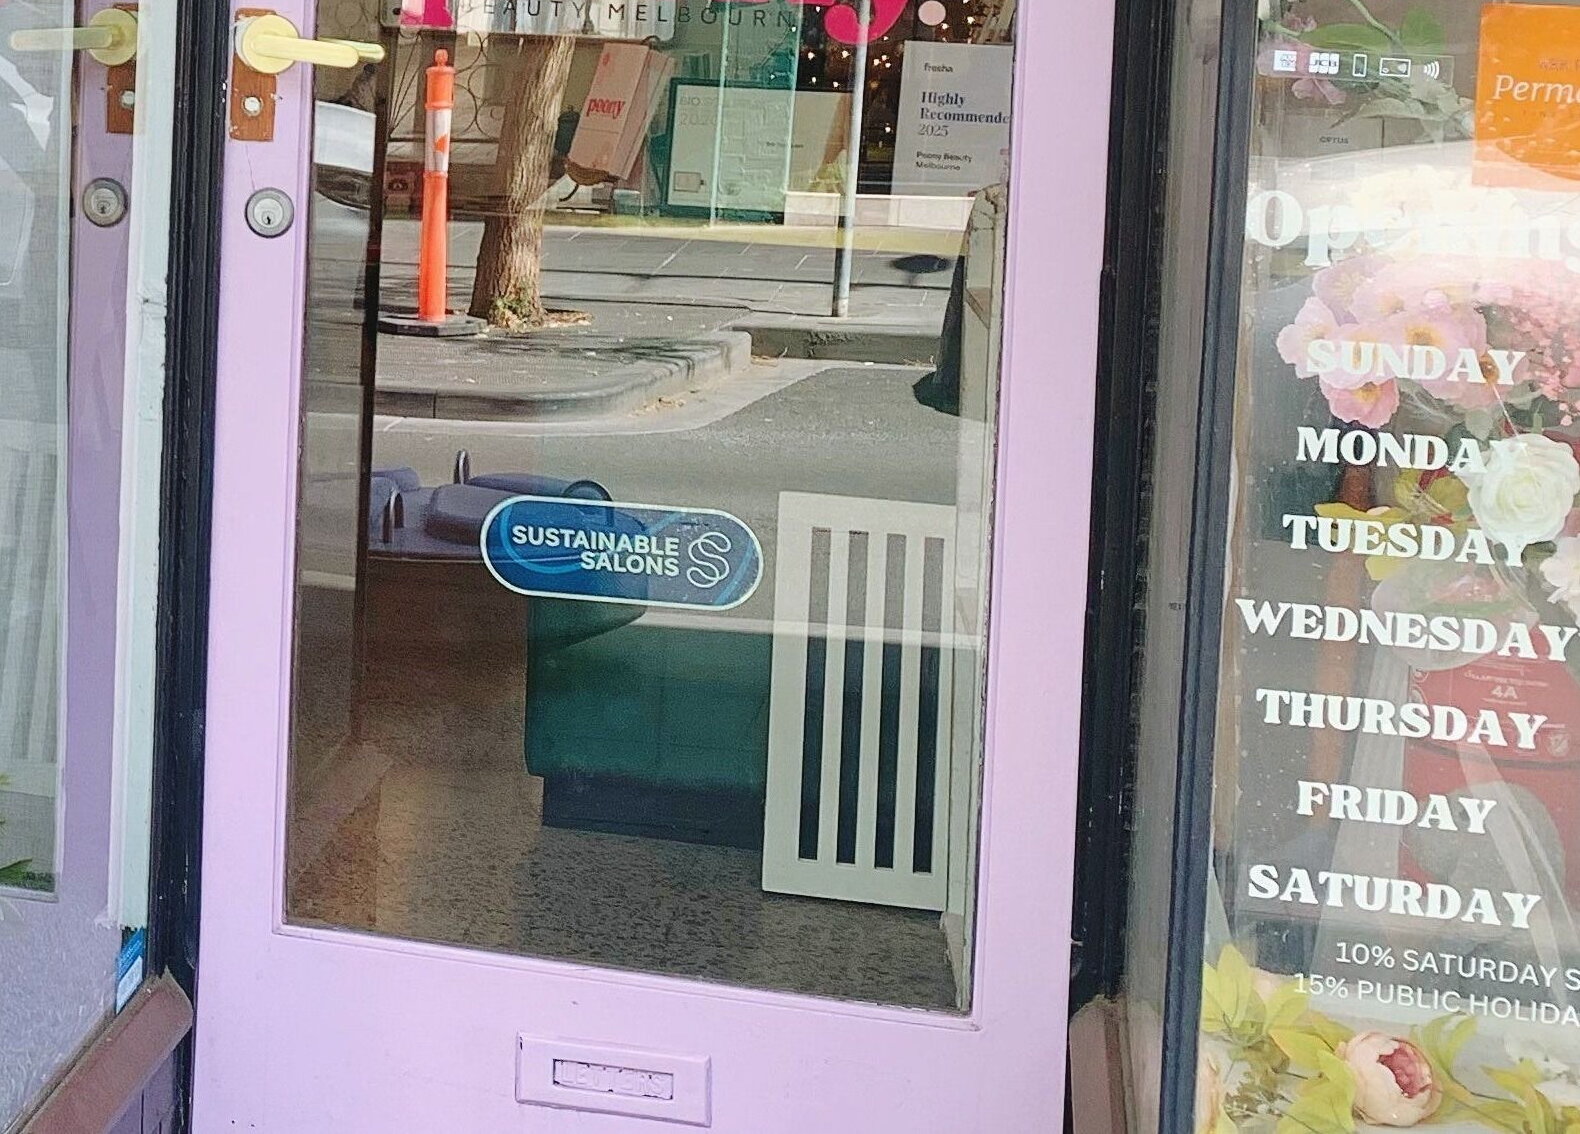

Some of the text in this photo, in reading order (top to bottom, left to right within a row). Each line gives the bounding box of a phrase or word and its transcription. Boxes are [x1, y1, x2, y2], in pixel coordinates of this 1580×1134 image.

[608, 3, 794, 28] MELBOURN
[586, 96, 626, 120] peony
[921, 91, 966, 108] Highly
[918, 124, 949, 137] 2025
[916, 151, 973, 163] Peony Beauty
[1306, 338, 1526, 385] SUNDAY
[1296, 426, 1528, 476] MONDAY
[511, 524, 680, 557] SUSTAINABLE
[1282, 514, 1524, 567] TUESDAY
[580, 552, 680, 577] SALONS
[1234, 598, 1578, 662] WEDNESDAY
[1256, 688, 1548, 750] THURSDAY
[1296, 780, 1498, 835] FRIDAY
[1248, 864, 1542, 930] SATURDAY
[1335, 941, 1396, 970] 10%
[1402, 949, 1559, 990] SATURDAY
[1292, 972, 1350, 1000] 15%
[1357, 980, 1461, 1013] PUBLIC
[559, 1064, 665, 1094] LETTERS
